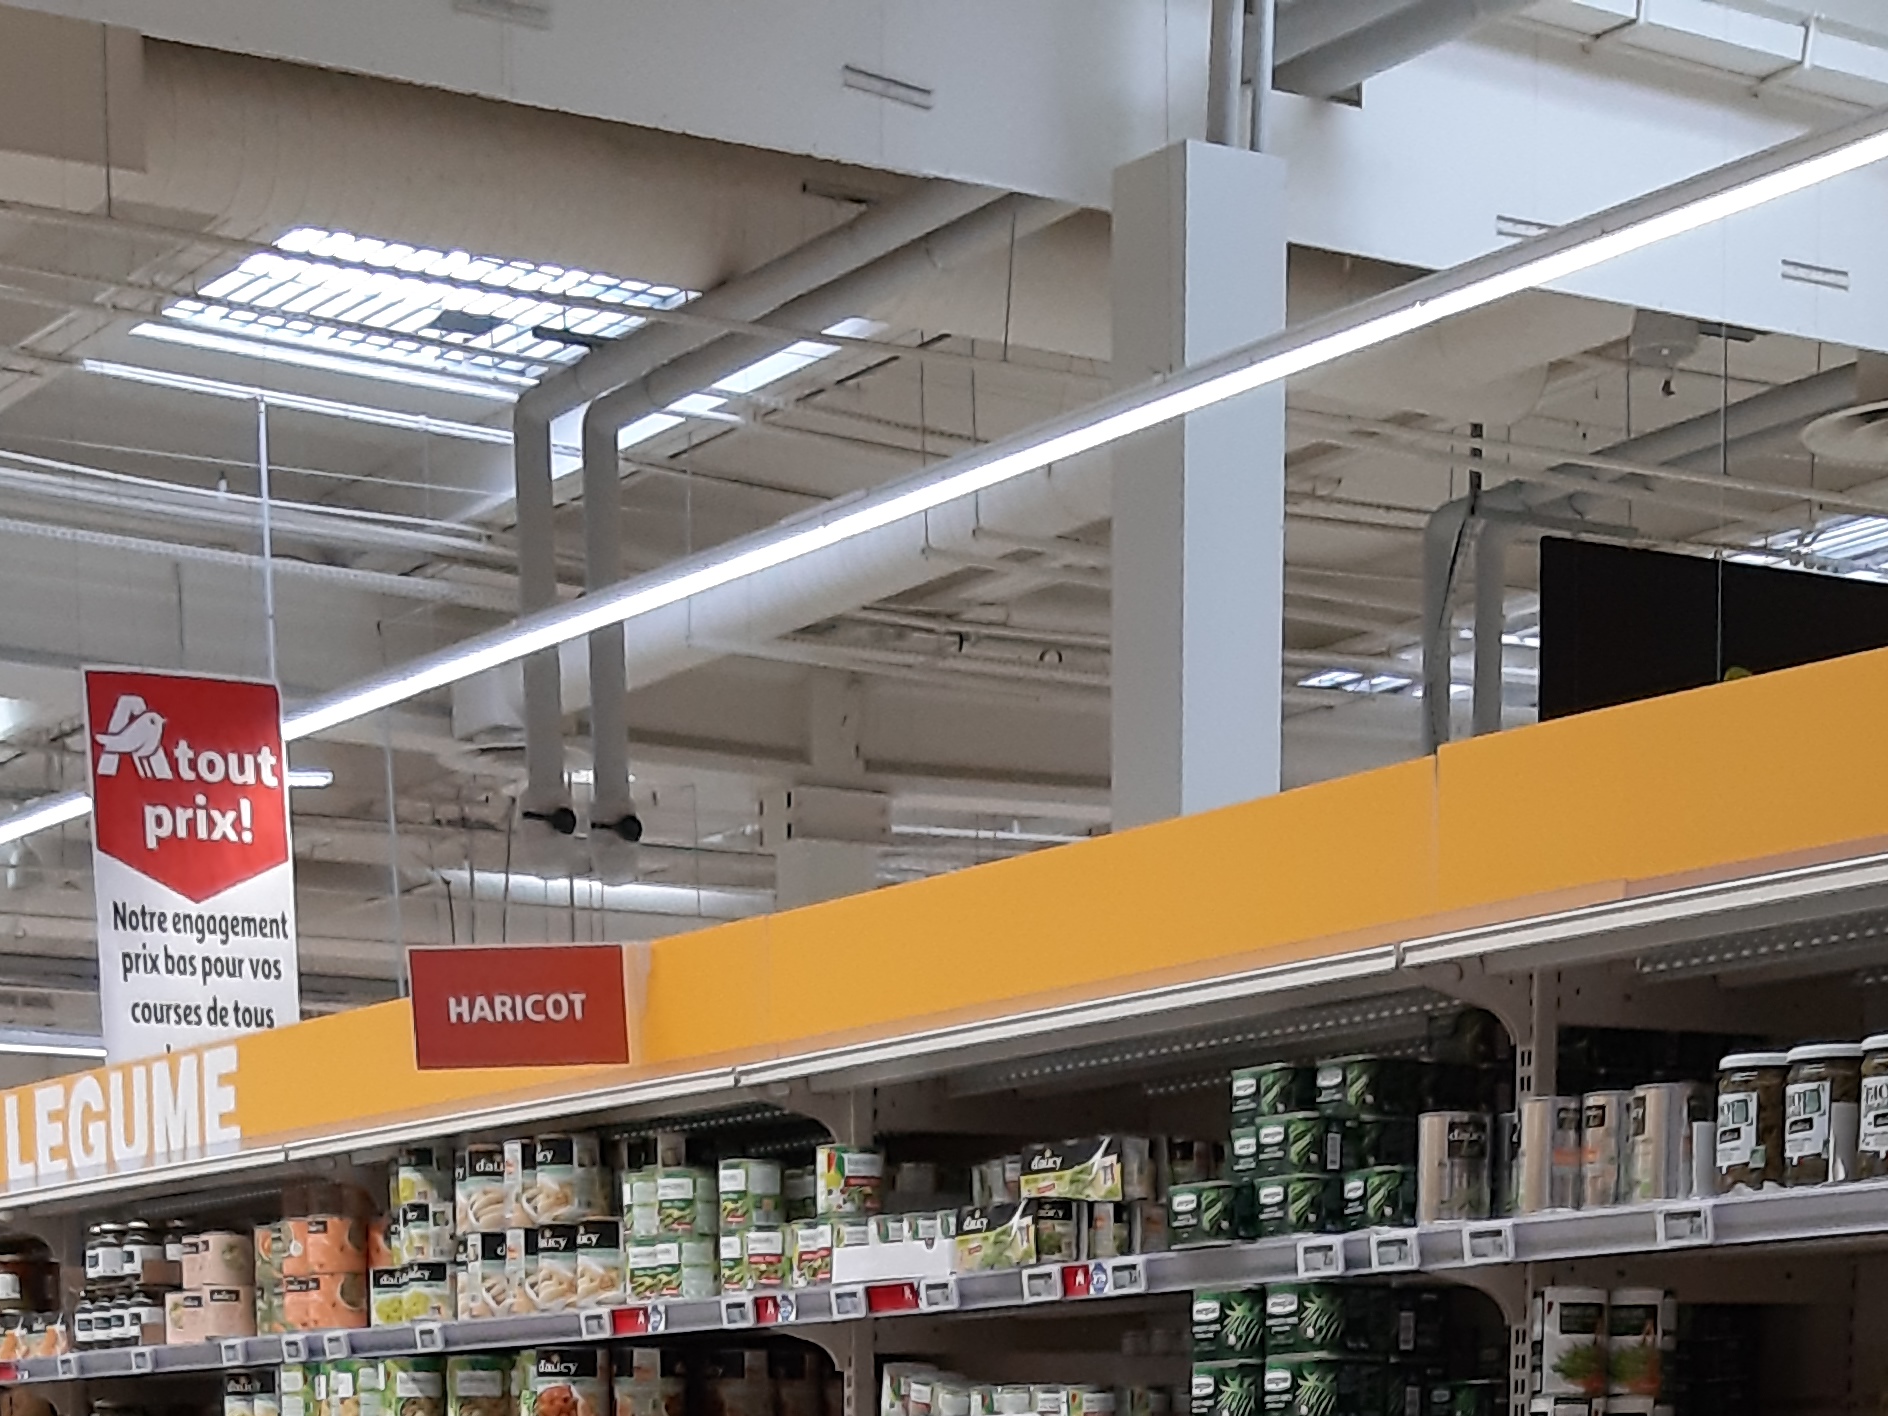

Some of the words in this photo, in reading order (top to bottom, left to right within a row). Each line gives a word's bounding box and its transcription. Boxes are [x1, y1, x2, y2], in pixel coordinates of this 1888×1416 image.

[173, 738, 278, 788] tout
[143, 793, 252, 850] prix!
[113, 901, 167, 933] Notre
[172, 910, 288, 946] engagement
[122, 943, 160, 983] prix
[164, 944, 197, 978] bas
[202, 954, 245, 986] pour
[250, 956, 281, 981] vos
[131, 1001, 202, 1027] courses
[206, 995, 229, 1028] de
[233, 1001, 275, 1029] tous
[447, 991, 586, 1024] HARICOT
[5, 1045, 241, 1182] LEGUME
